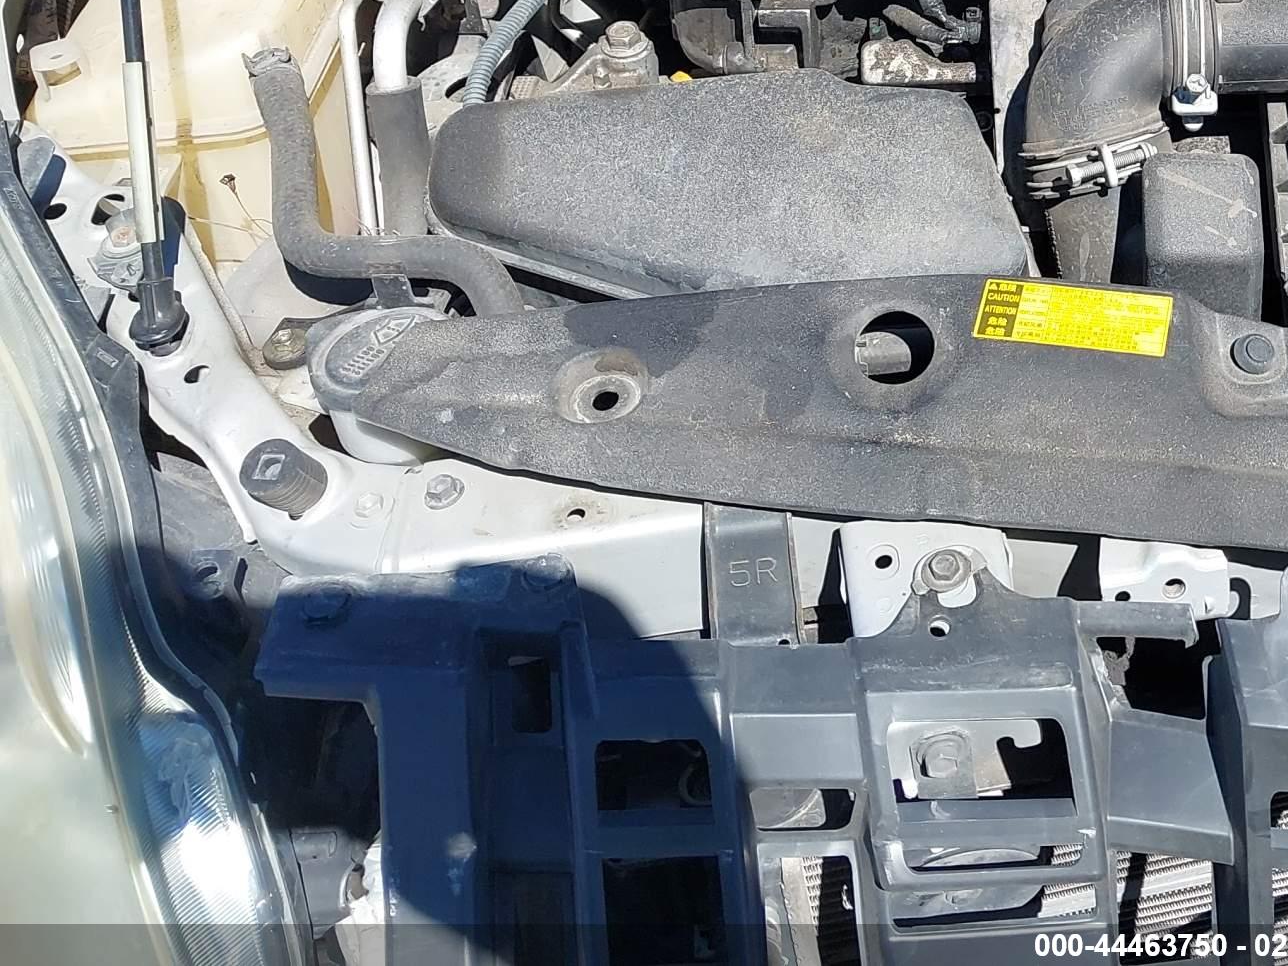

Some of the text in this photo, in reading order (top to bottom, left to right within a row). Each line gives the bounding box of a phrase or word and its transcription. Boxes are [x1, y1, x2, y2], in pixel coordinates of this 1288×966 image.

[988, 293, 1021, 303] CAUTION
[984, 305, 1017, 315] ATTENTION
[729, 557, 778, 587] 5R
